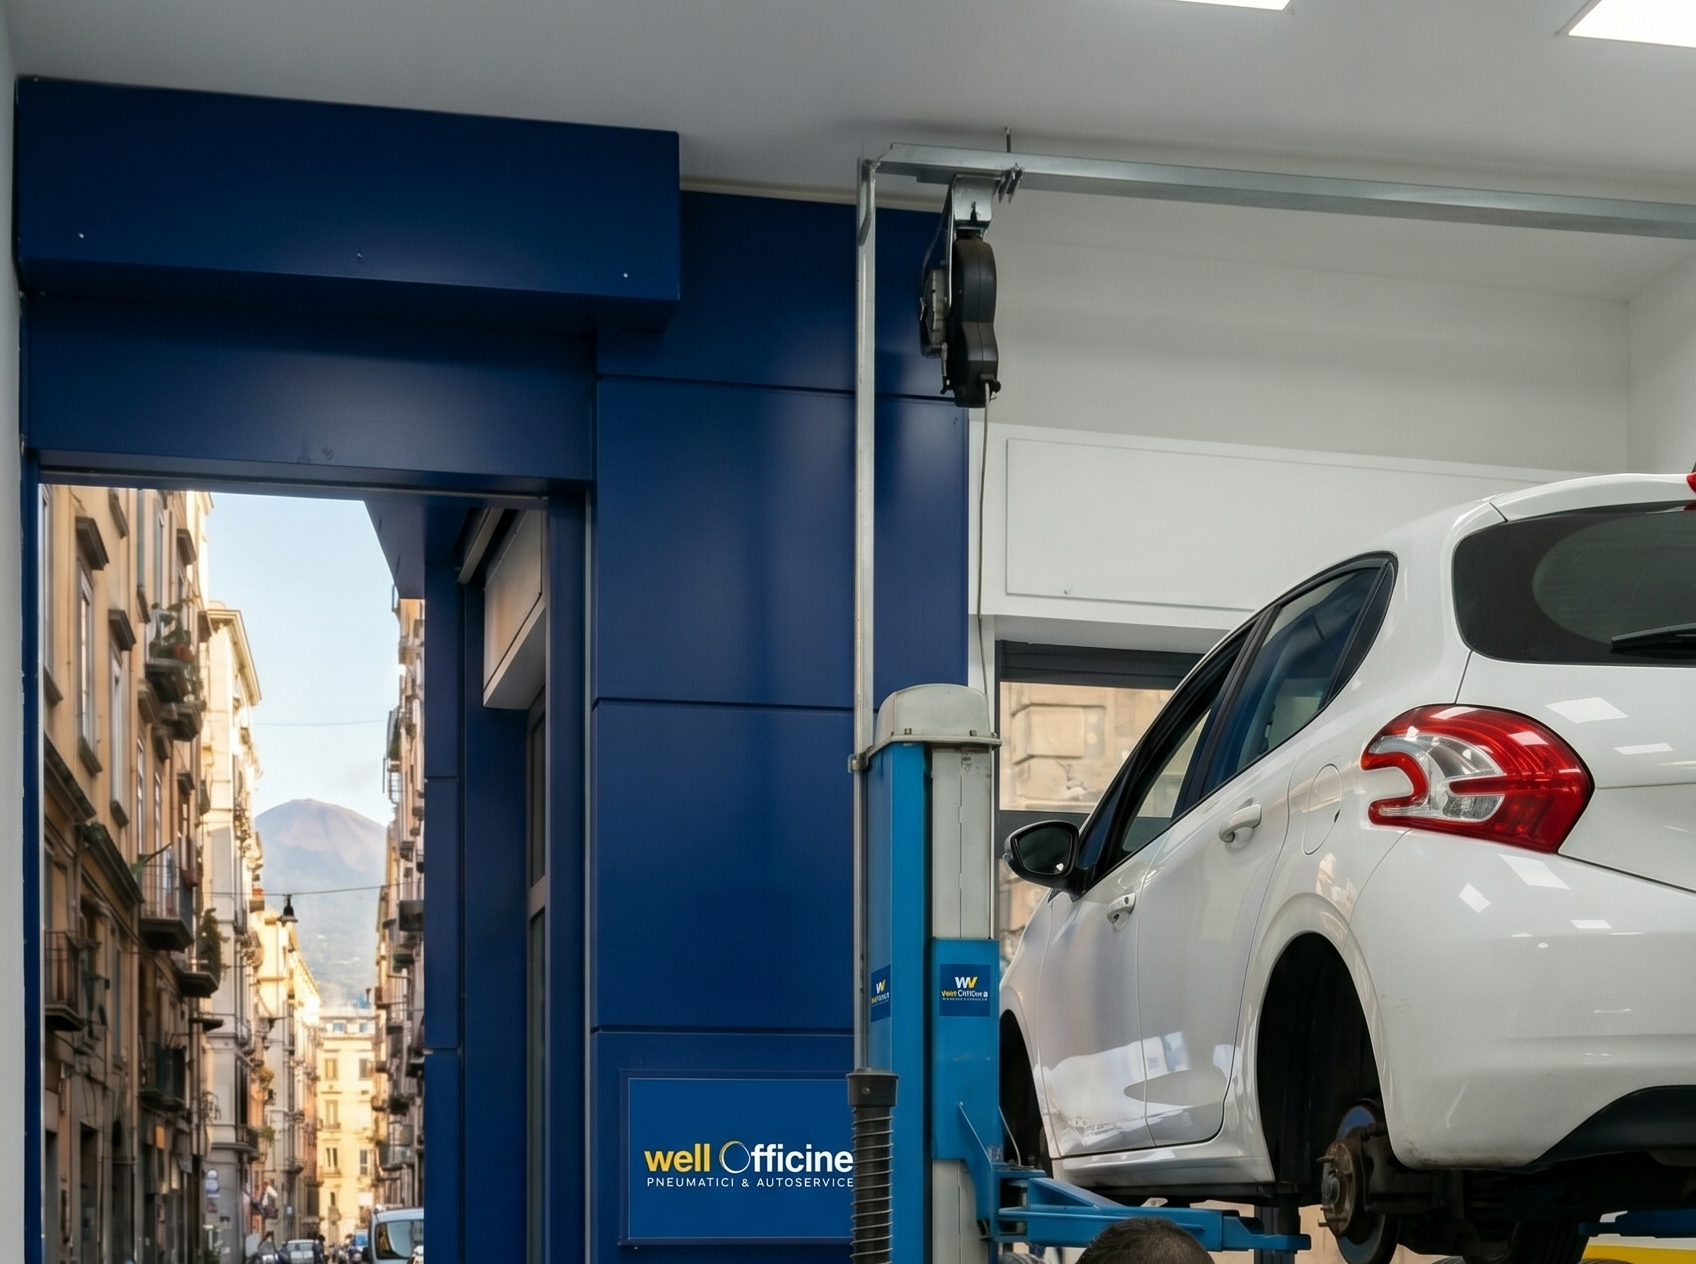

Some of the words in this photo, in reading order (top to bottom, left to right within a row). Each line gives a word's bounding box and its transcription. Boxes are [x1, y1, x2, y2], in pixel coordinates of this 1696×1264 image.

[644, 1143, 711, 1172] well
[718, 1140, 854, 1174] Officine
[646, 1177, 734, 1188] PNEUMATICI
[741, 1178, 750, 1188] &
[756, 1177, 854, 1188] AUTOSERVICE
